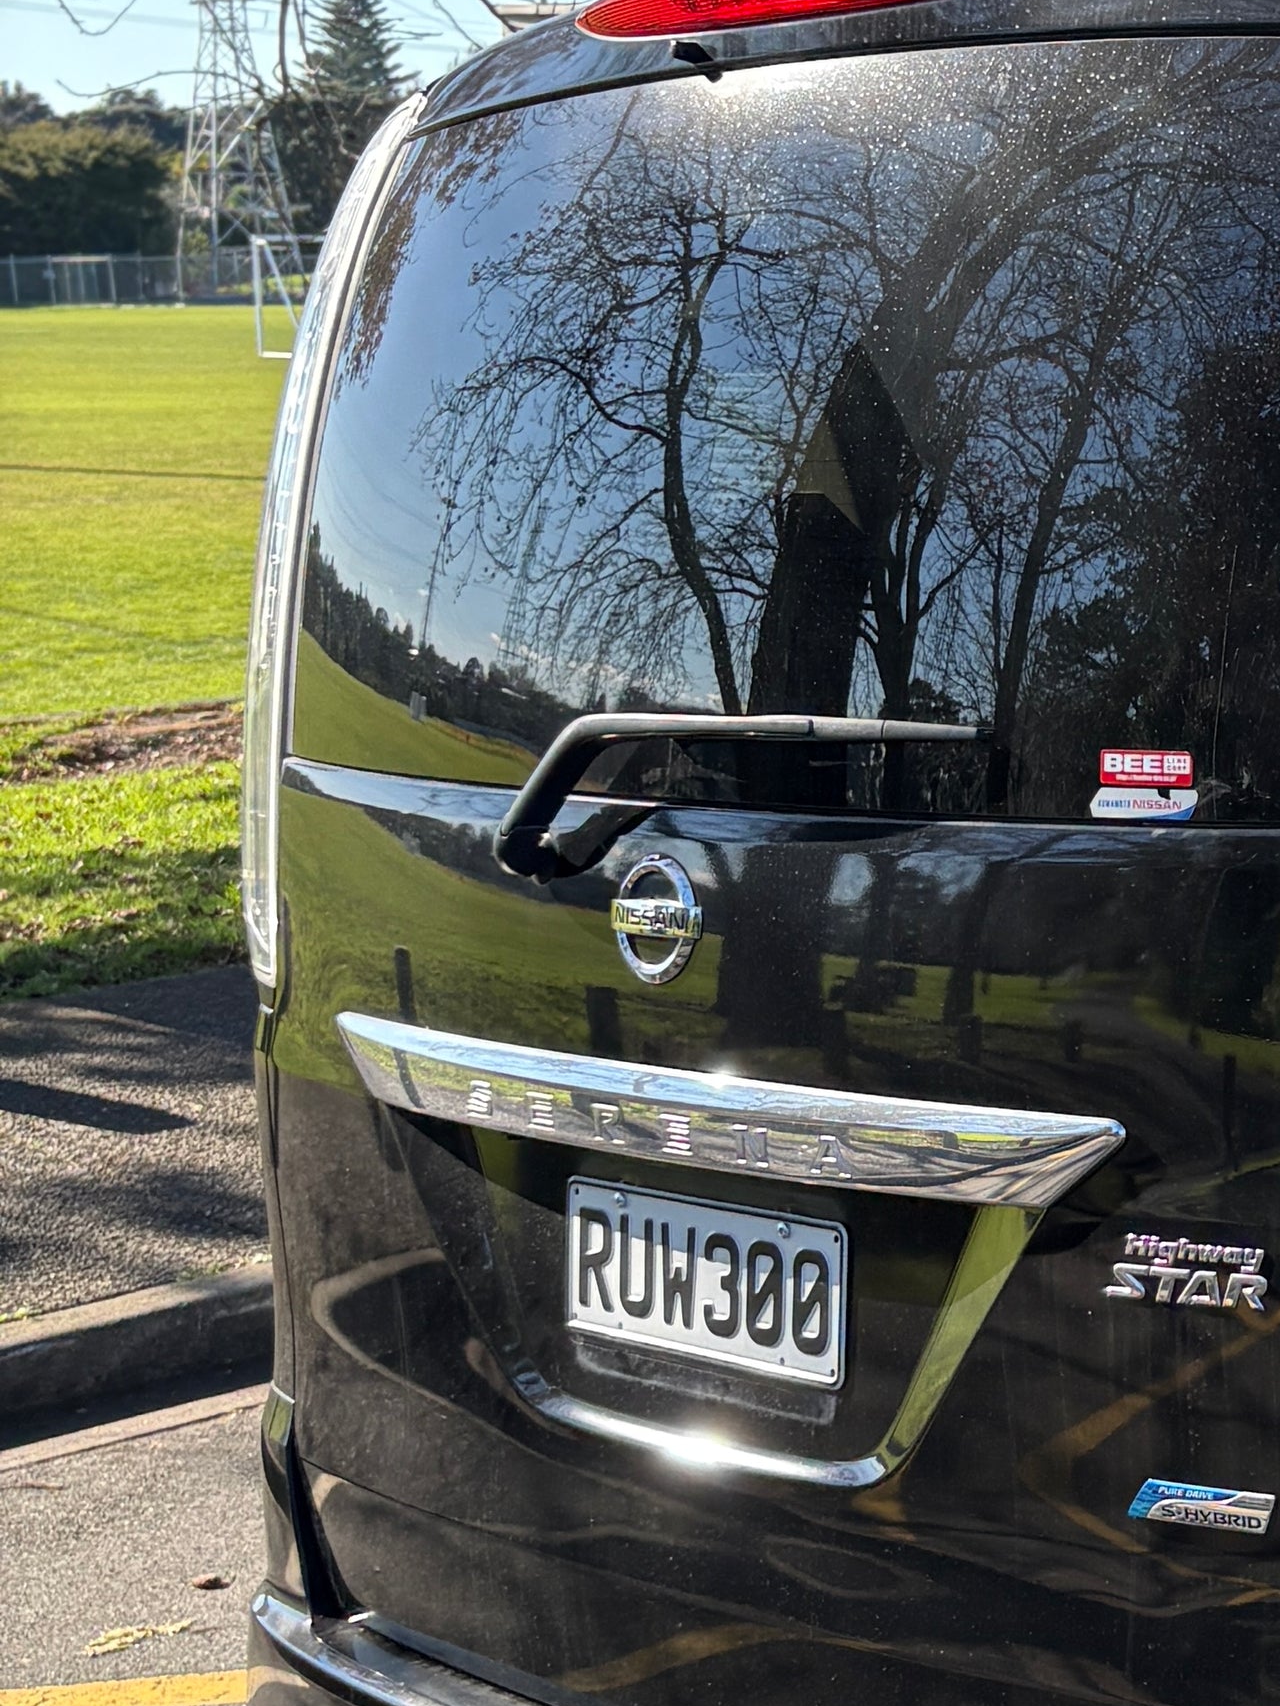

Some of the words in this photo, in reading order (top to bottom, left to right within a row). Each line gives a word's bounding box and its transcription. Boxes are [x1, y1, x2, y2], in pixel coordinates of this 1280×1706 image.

[1103, 753, 1163, 773] BEE
[1132, 799, 1182, 810] NISSAN
[615, 902, 687, 931] NISSAN
[466, 1079, 853, 1180] SERENA
[1123, 1232, 1265, 1274] Highway
[578, 1205, 831, 1357] RUW300
[1104, 1262, 1268, 1312] STAR
[1157, 1486, 1184, 1498] PURE
[1185, 1489, 1215, 1501] DRIVE
[1161, 1505, 1262, 1530] S-HYBRID
